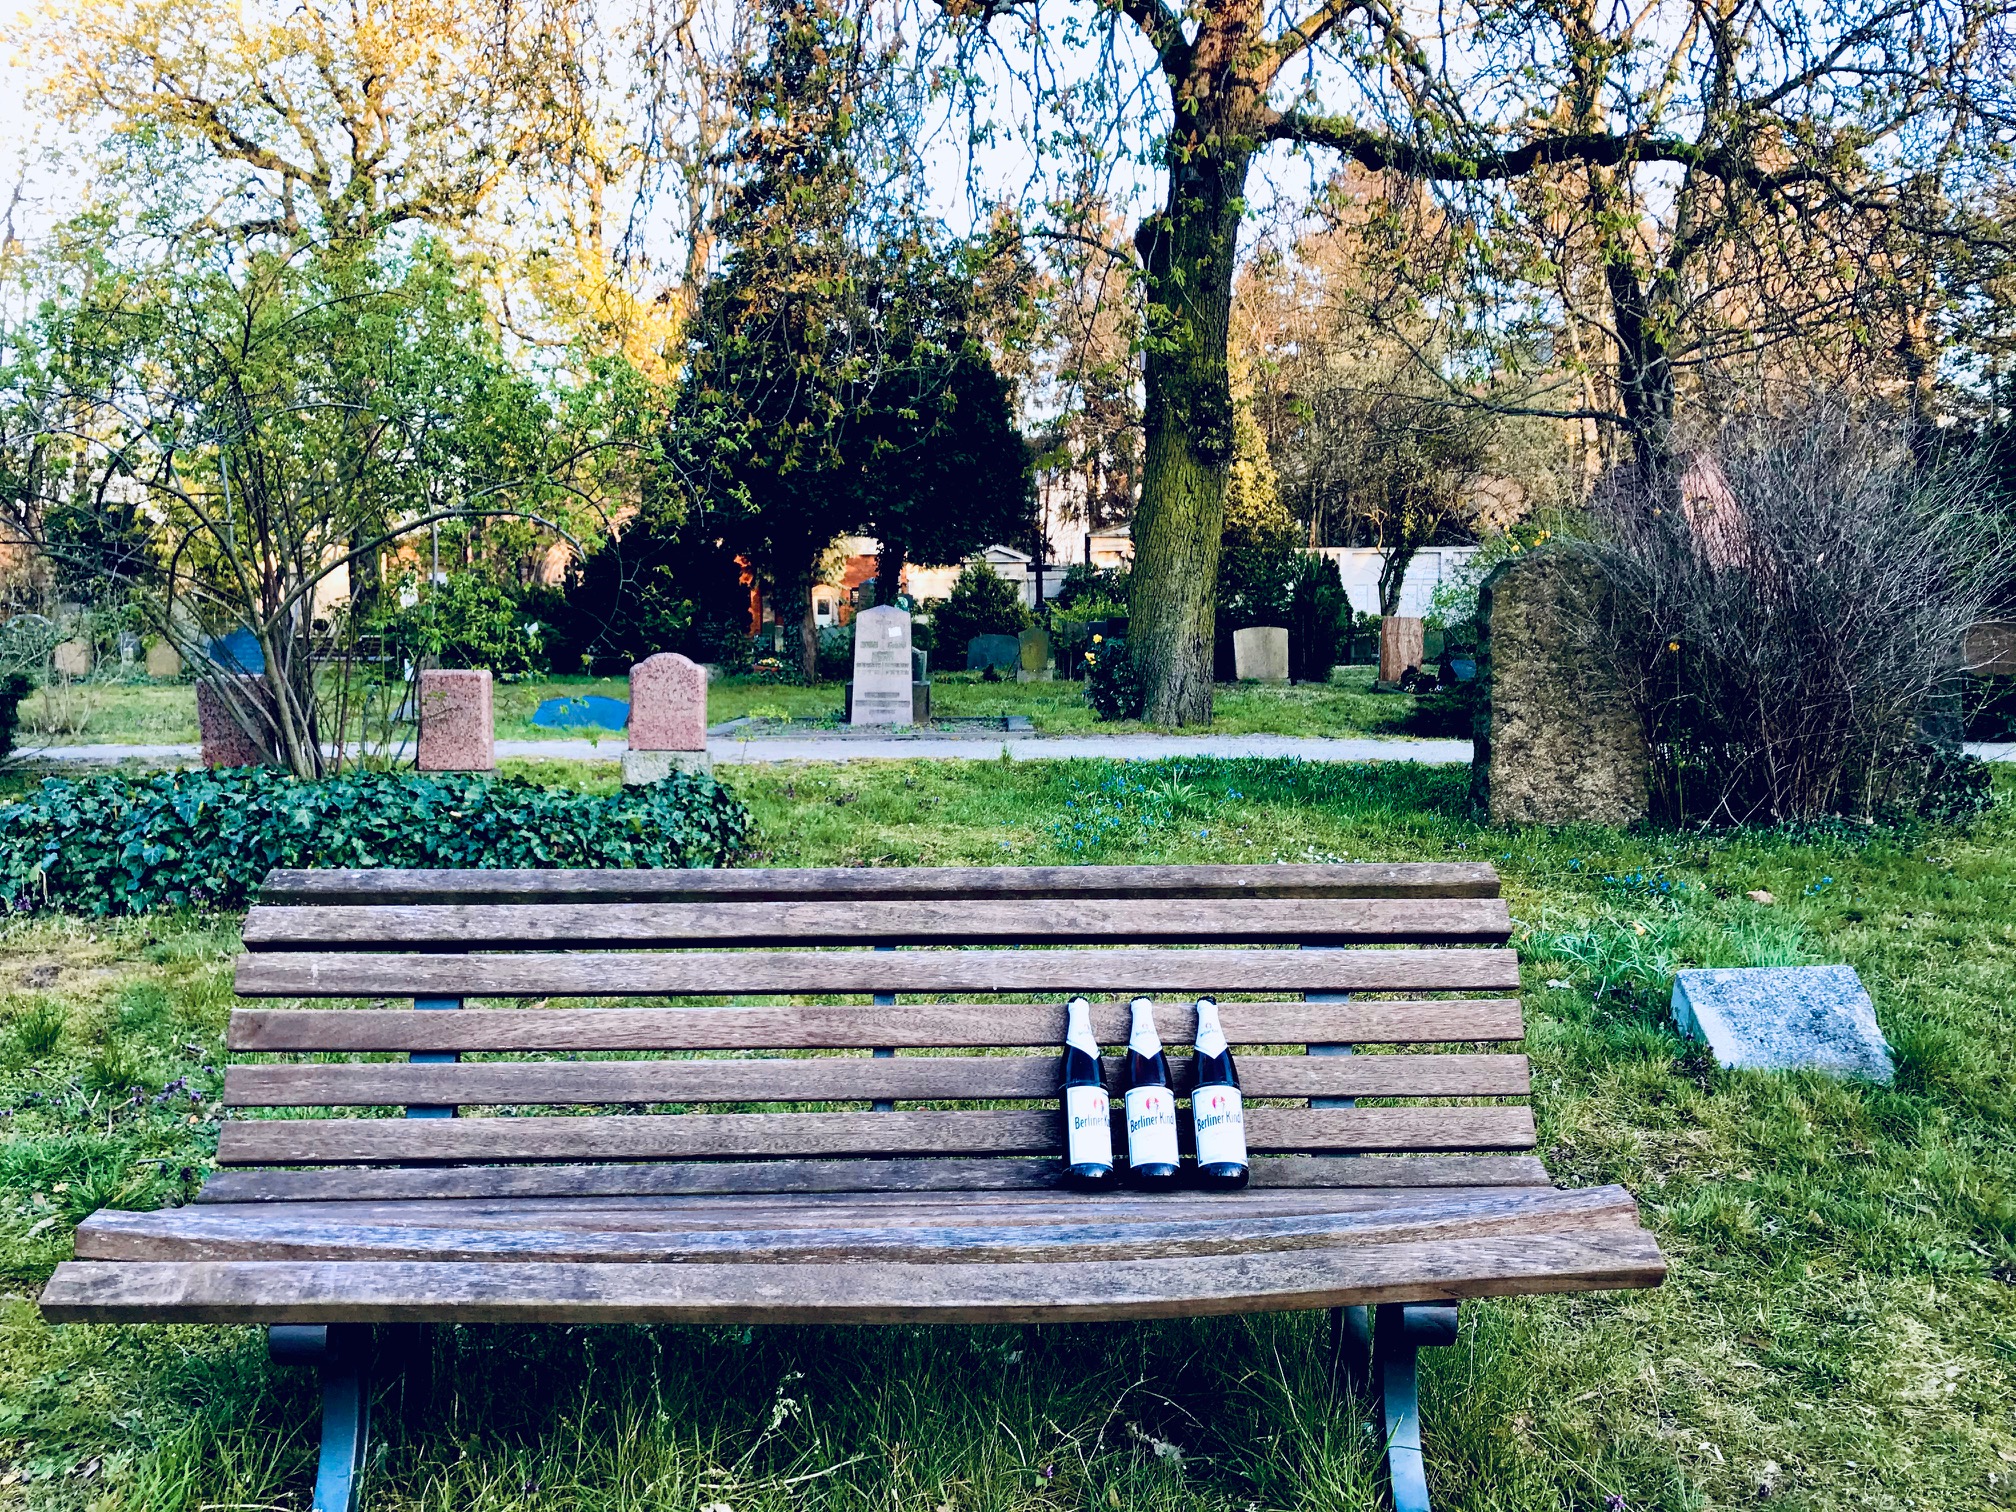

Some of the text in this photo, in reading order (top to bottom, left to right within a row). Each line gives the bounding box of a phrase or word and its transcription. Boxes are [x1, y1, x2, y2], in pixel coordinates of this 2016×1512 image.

[1074, 1115, 1103, 1129] Berliner
[1130, 1115, 1157, 1133] Berliner
[1197, 1114, 1224, 1132] Berliner
